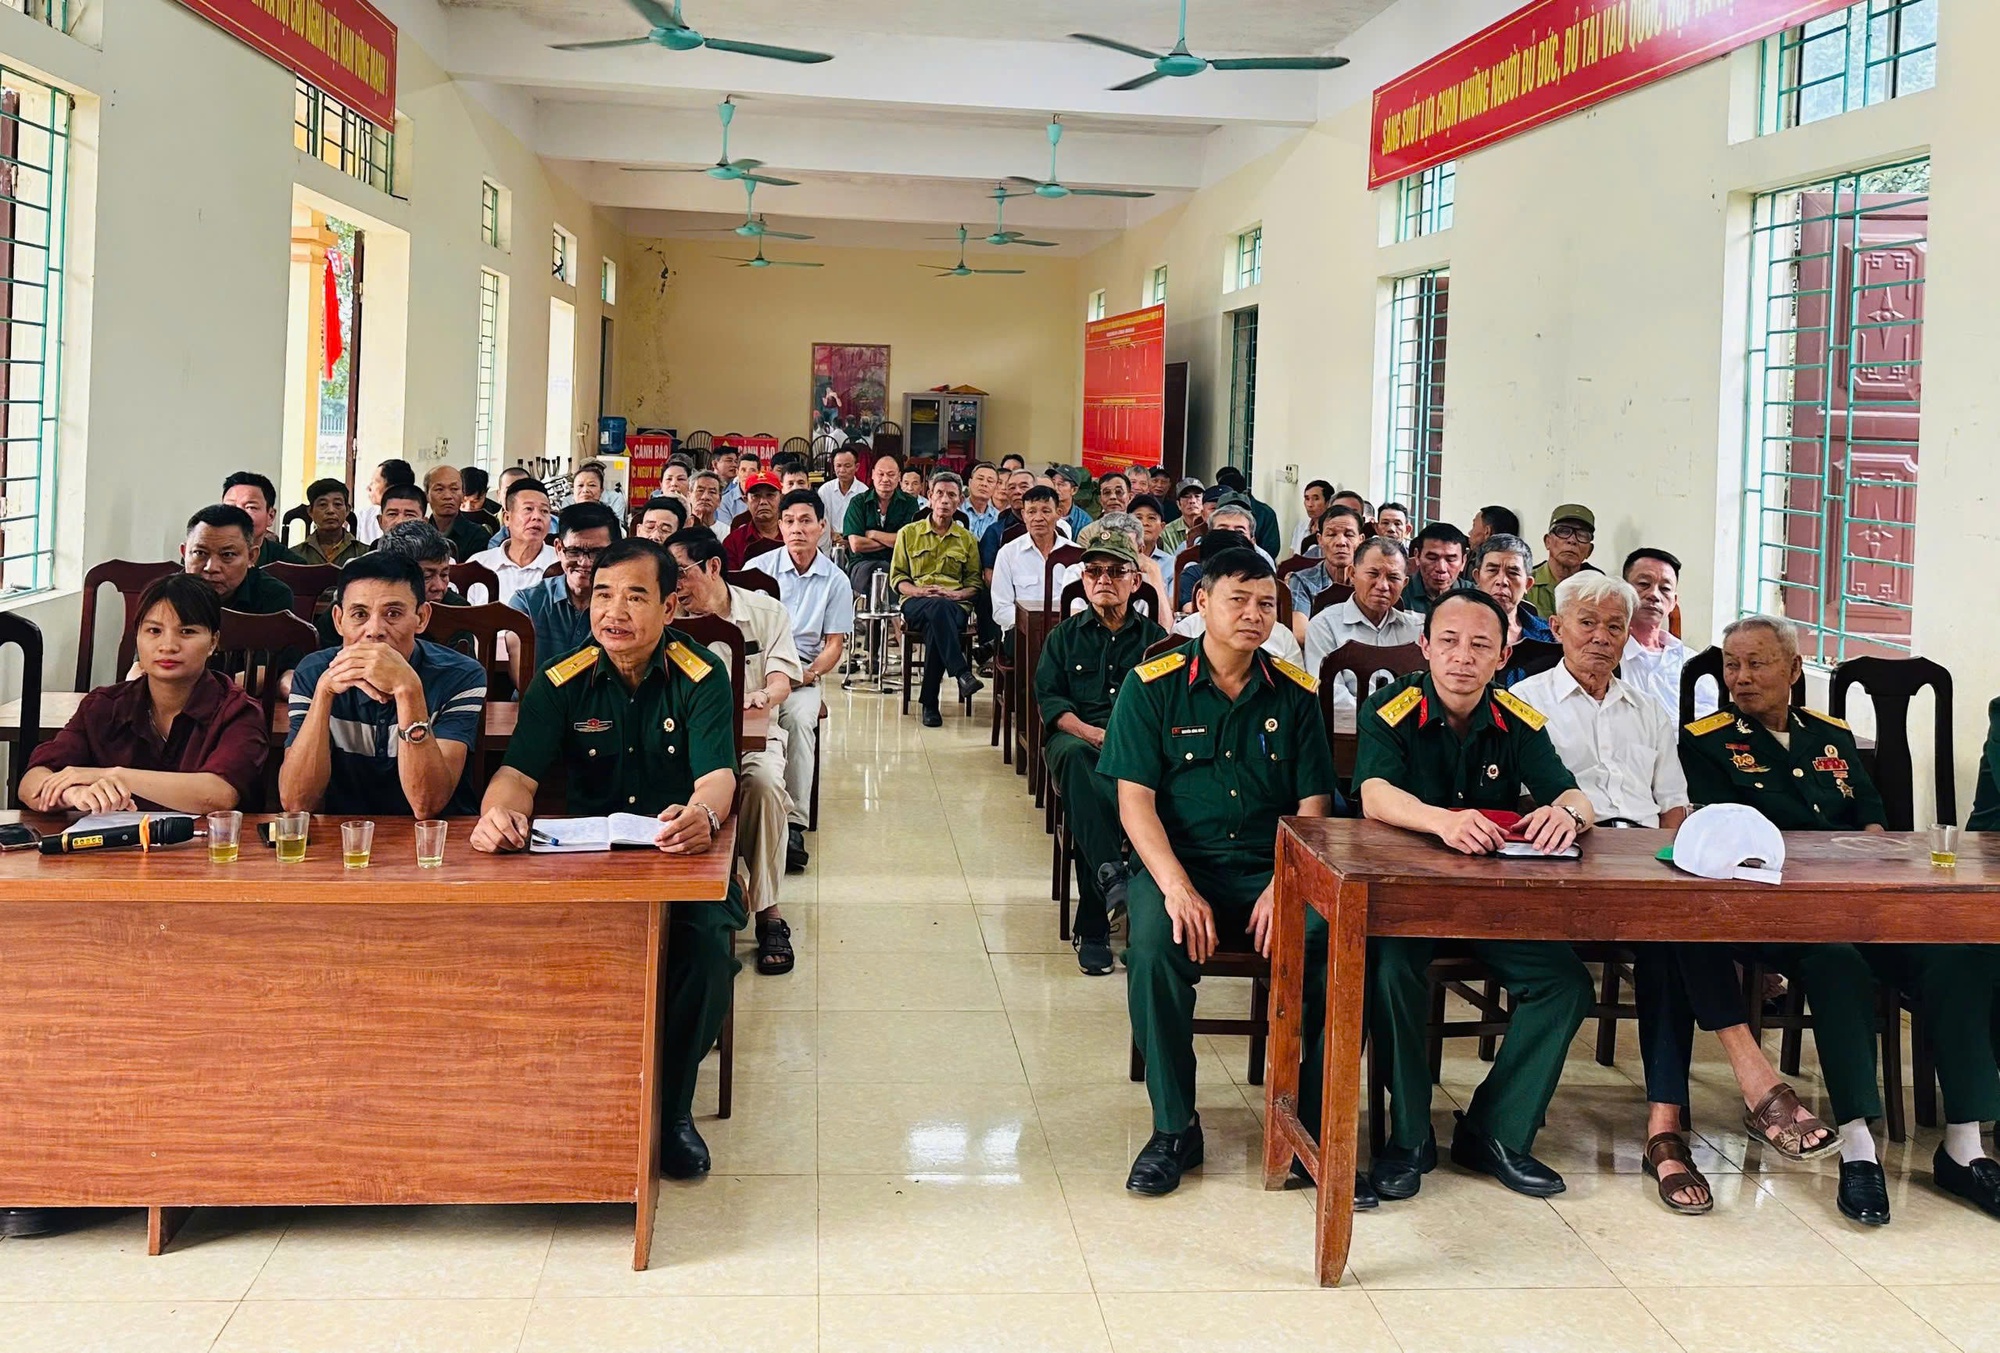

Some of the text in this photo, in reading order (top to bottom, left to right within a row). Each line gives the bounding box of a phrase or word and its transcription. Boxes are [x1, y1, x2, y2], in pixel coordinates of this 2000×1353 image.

[1382, 108, 1401, 156] SÁNG
[1401, 89, 1421, 148] SUỐT
[1420, 92, 1435, 148] LỰA
[1436, 83, 1460, 138] CHỌN
[1459, 66, 1490, 123] NHỮNG
[1491, 43, 1521, 109] NGƯỜI
[1521, 28, 1537, 95] ĐỦ
[1536, 26, 1561, 88] ĐỨC,
[1562, 5, 1580, 76] ĐỦ
[1581, 4, 1600, 68] TÀI
[634, 438, 669, 460] CẢNH BÁO
